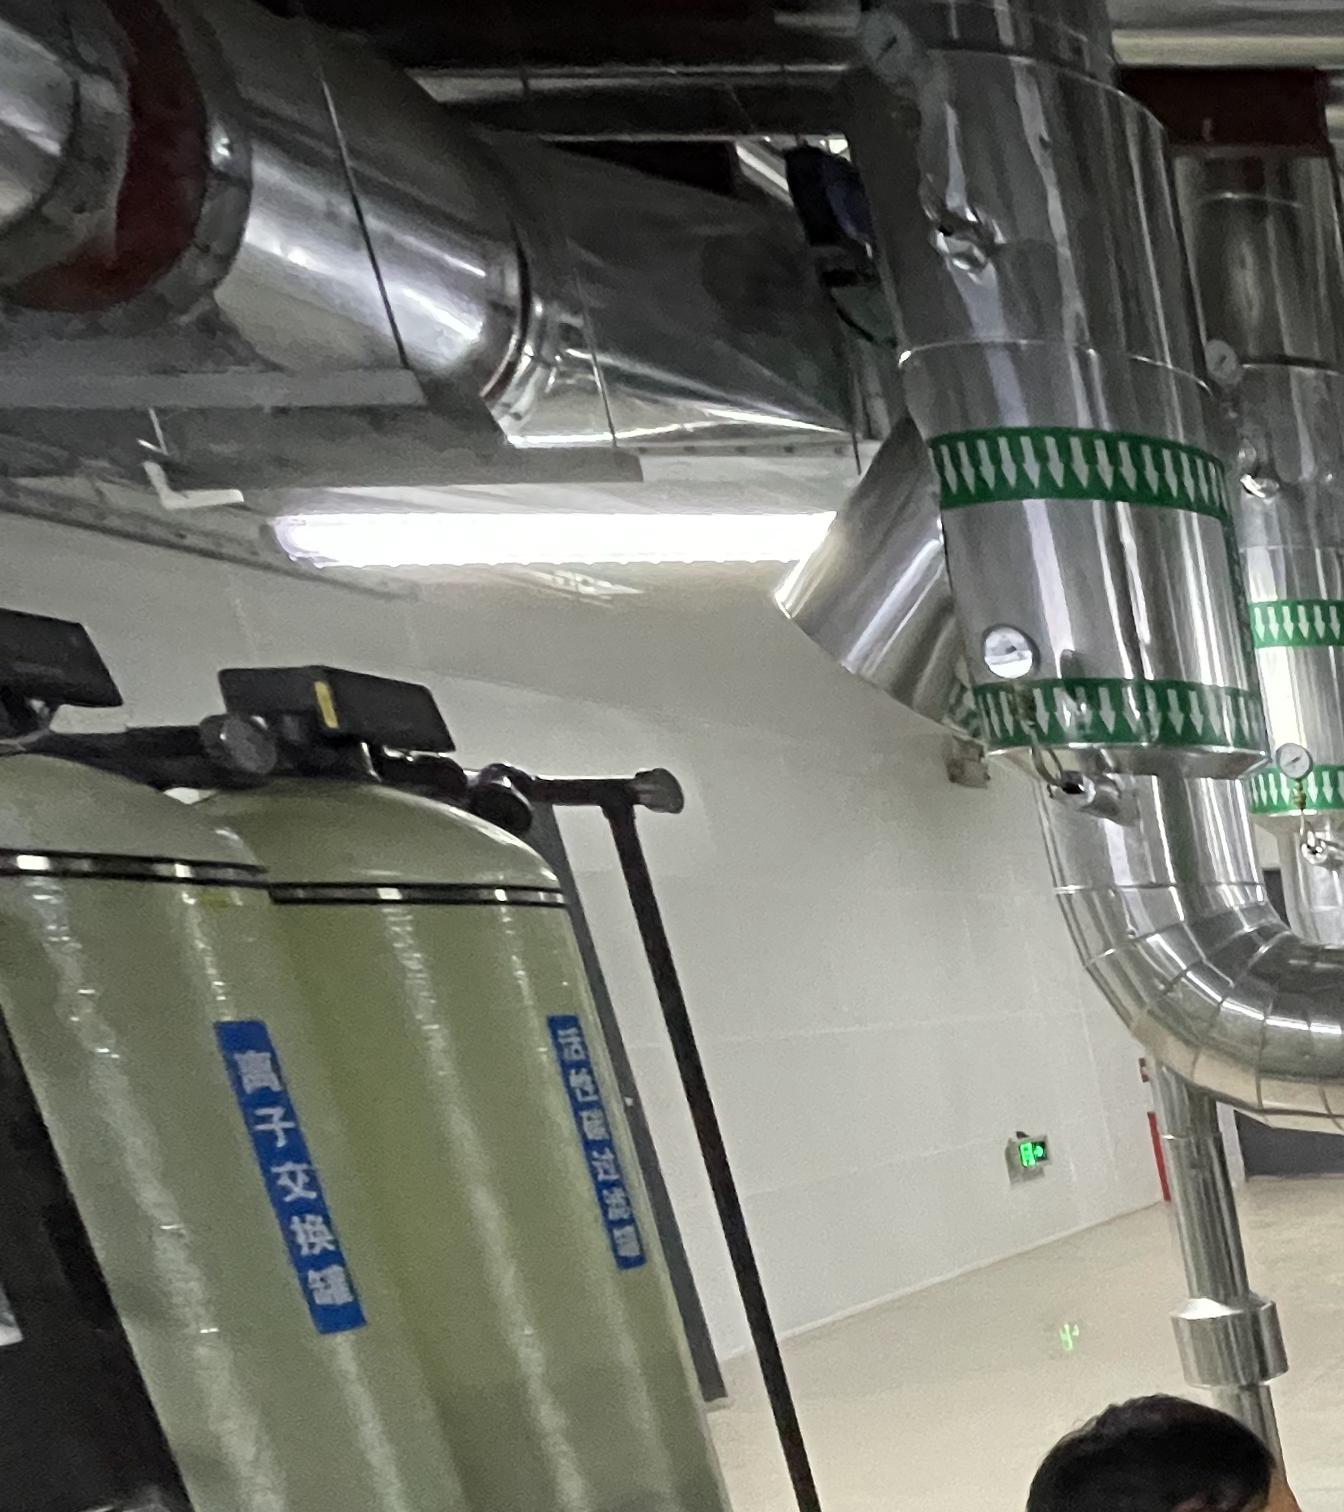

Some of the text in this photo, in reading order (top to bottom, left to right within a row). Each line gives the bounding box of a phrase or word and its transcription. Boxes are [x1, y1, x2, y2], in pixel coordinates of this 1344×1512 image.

[234, 1050, 355, 1306] 离子交换罐
